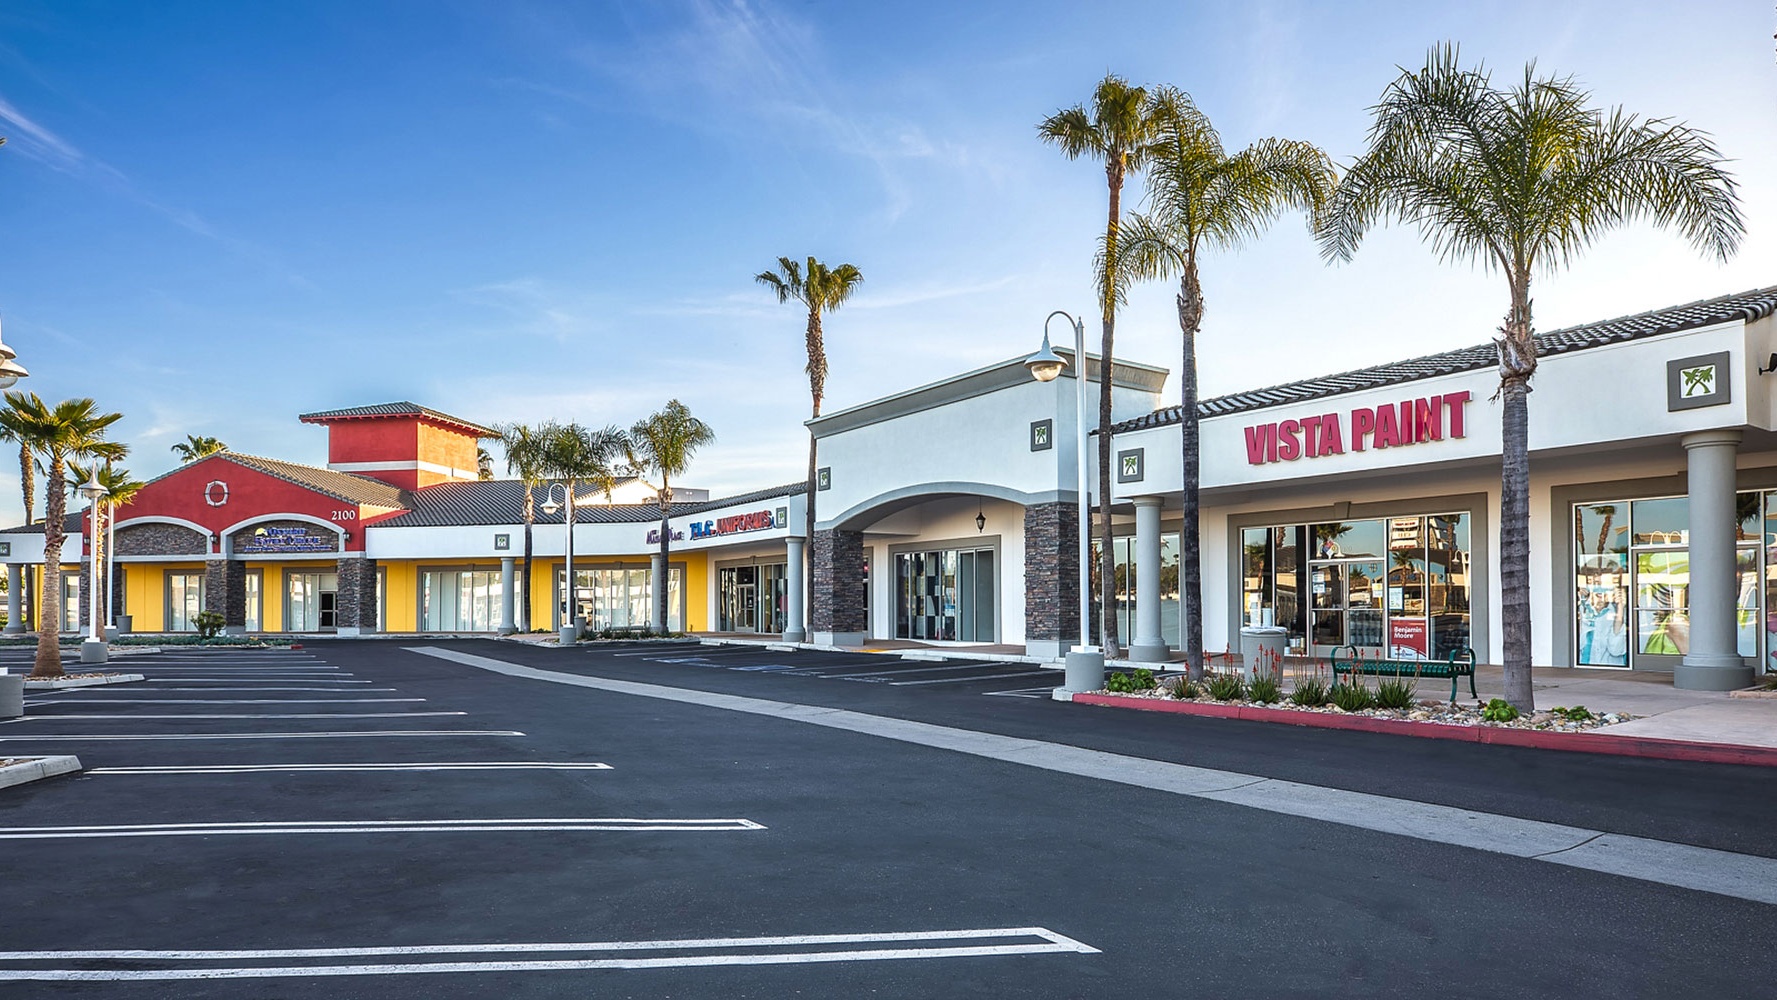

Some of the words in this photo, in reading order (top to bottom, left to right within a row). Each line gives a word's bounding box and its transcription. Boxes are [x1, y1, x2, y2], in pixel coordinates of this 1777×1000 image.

[1244, 413, 1344, 465] VISTA
[1351, 390, 1473, 452] PAINT
[331, 510, 356, 521] 2100
[716, 510, 772, 535] UNIFORMS
[1394, 626, 1422, 634] Benjamin
